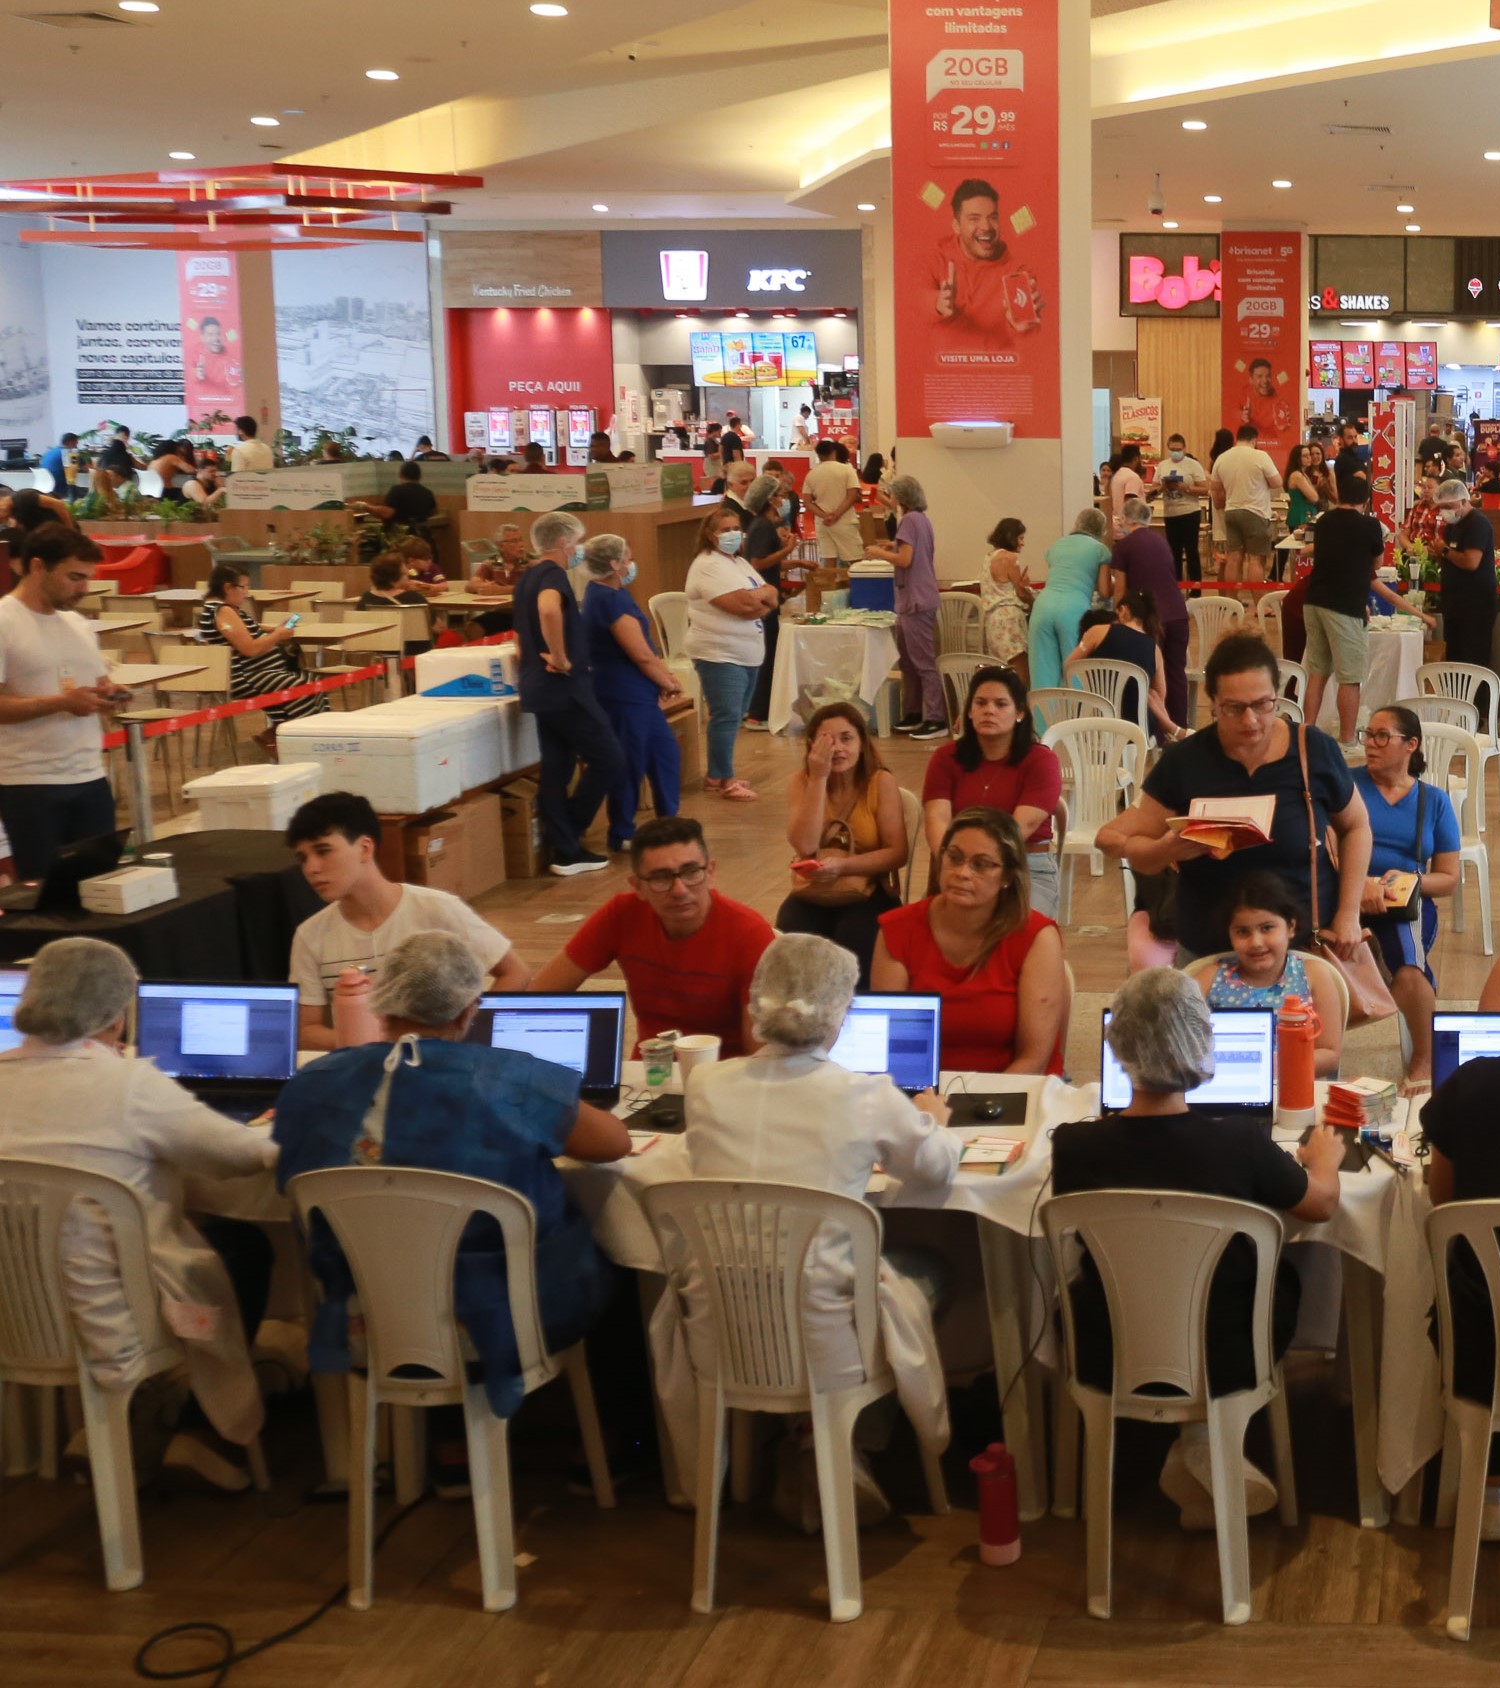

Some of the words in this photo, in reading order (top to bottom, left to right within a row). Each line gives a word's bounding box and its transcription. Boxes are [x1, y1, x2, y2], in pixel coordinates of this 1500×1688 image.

[925, 7, 954, 17] com
[956, 6, 1023, 19] vantagens
[944, 22, 1008, 33] ilimitadas
[943, 57, 1009, 77] 20GB
[933, 121, 948, 132] R$
[951, 105, 996, 135] 29
[746, 268, 807, 292] KFC
[513, 284, 536, 297] Fried
[1308, 295, 1321, 310] S
[1321, 286, 1340, 310] &
[1340, 295, 1389, 310] SHAKES
[1246, 301, 1277, 311] 20GB
[76, 319, 122, 331] Vamos
[1248, 323, 1271, 338] 29
[791, 335, 806, 349] 67
[940, 355, 968, 363] VISITE
[991, 355, 1015, 363] LOJA
[508, 381, 543, 395] PEÇA
[827, 426, 848, 435] KFC
